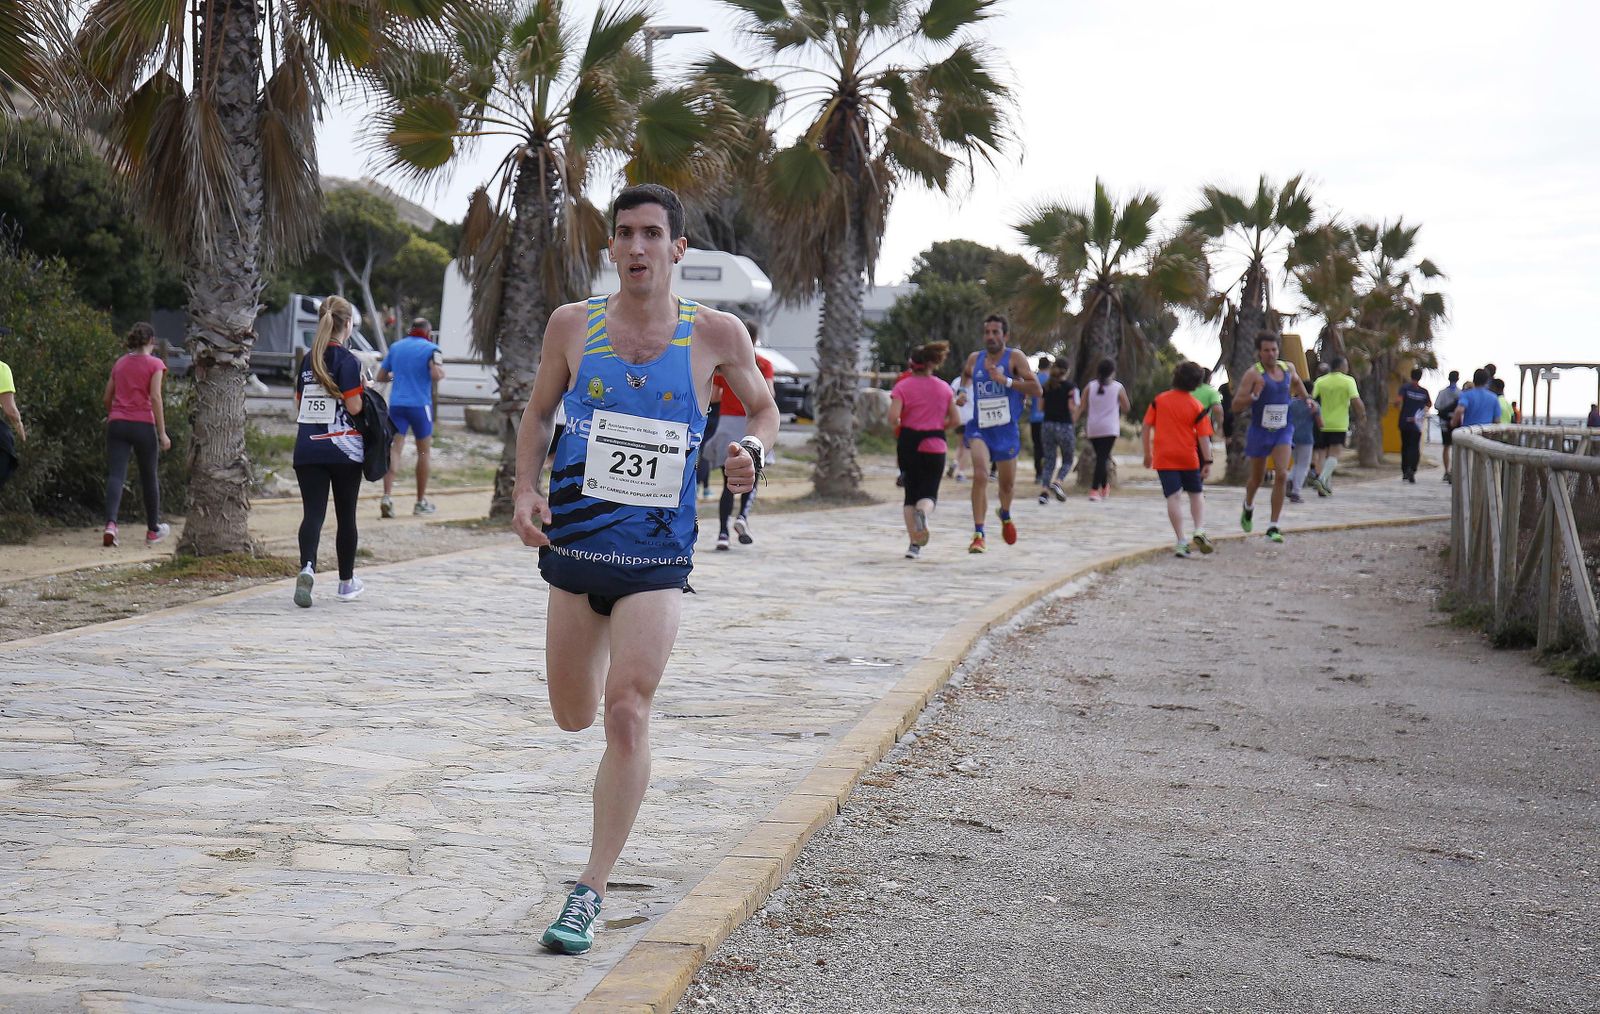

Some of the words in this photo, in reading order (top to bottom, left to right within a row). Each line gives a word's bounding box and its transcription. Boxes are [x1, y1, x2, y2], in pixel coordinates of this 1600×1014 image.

[308, 401, 326, 411] 755
[609, 451, 658, 479] 231
[607, 486, 629, 495] CARRERA
